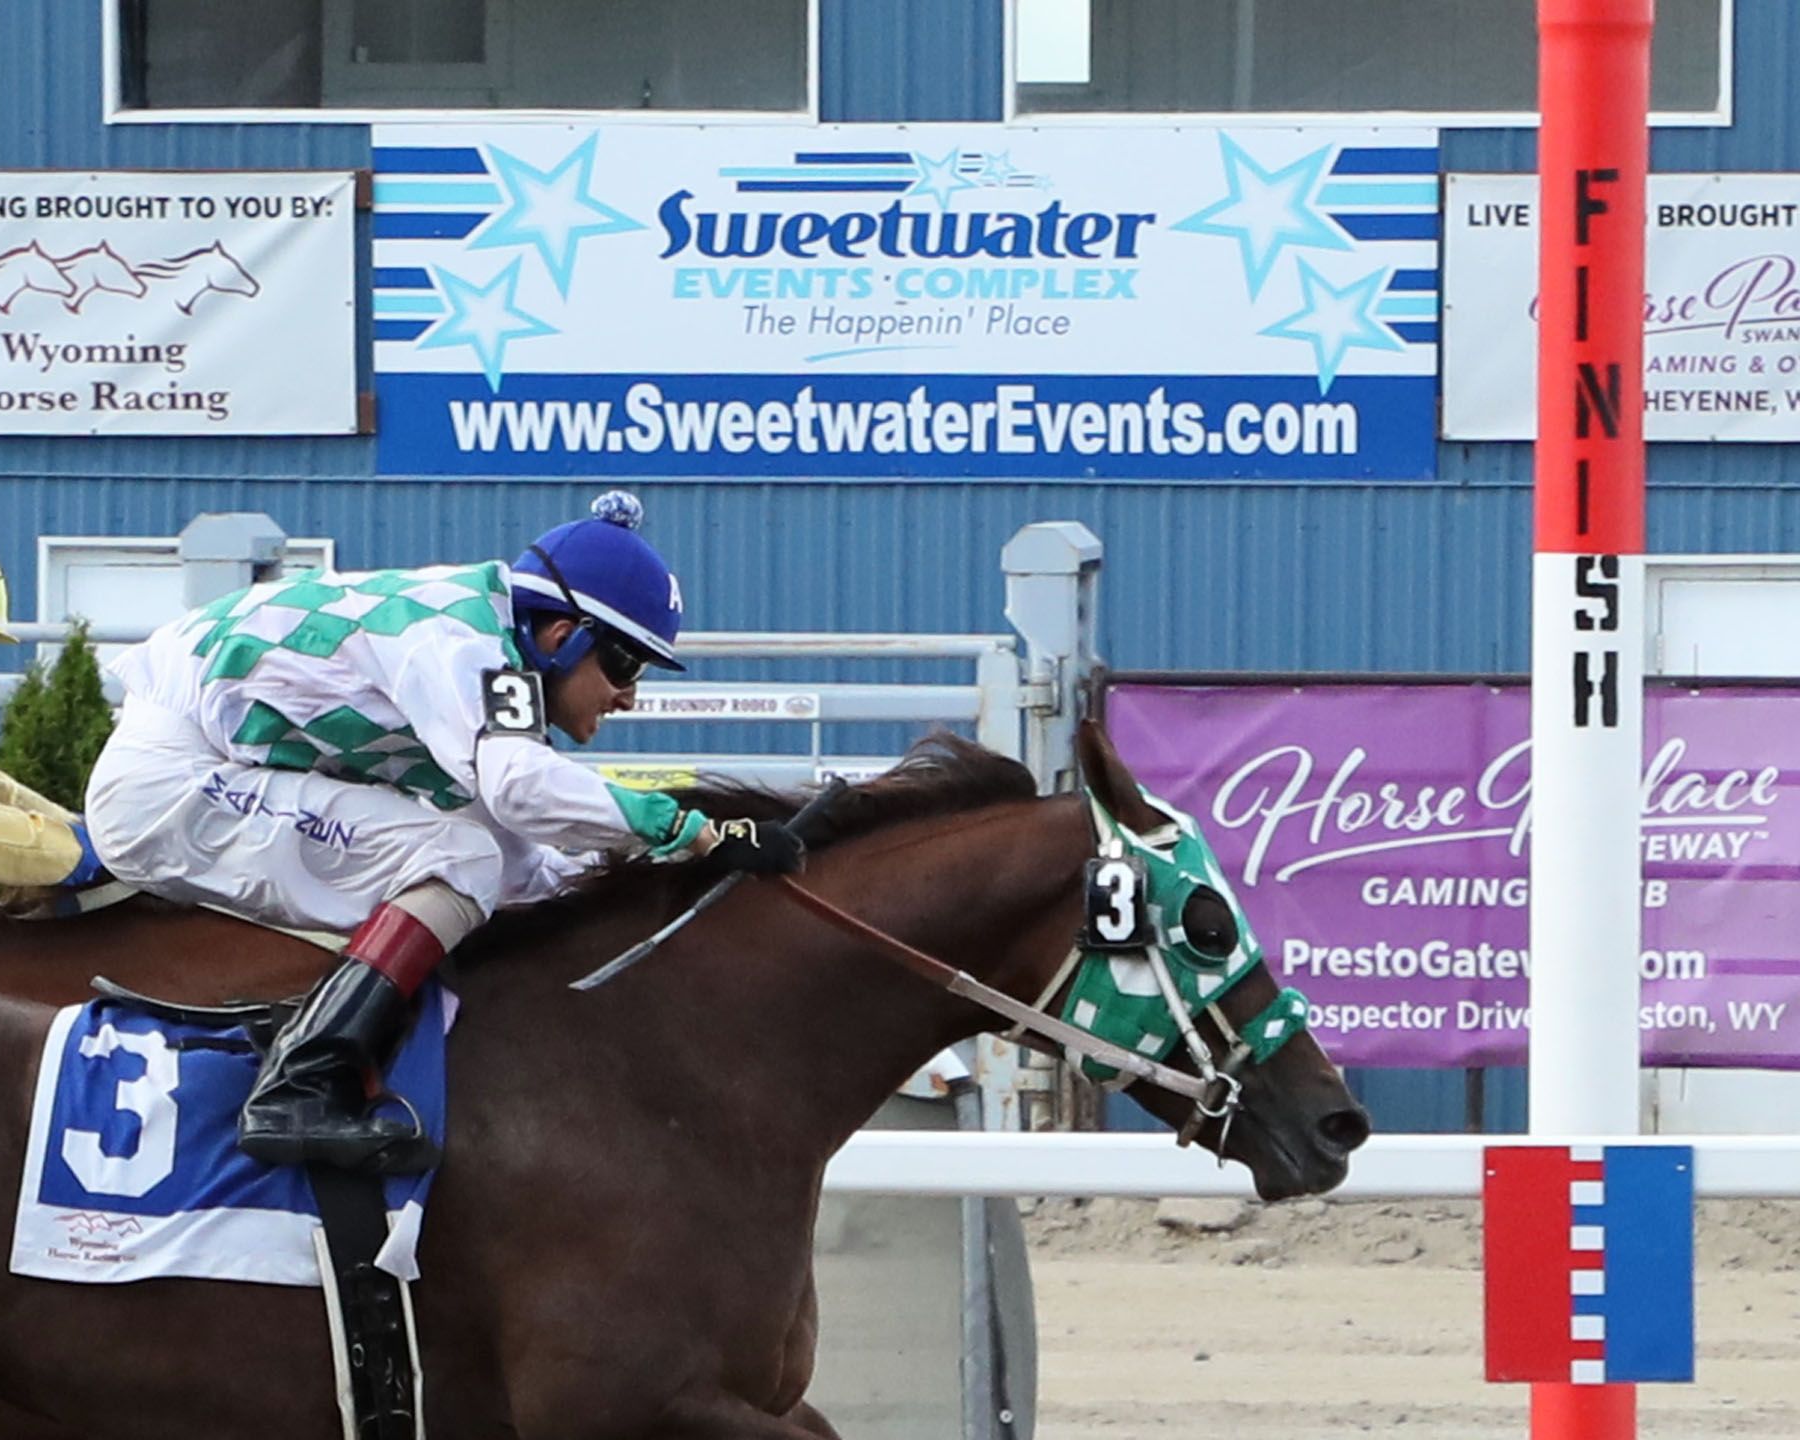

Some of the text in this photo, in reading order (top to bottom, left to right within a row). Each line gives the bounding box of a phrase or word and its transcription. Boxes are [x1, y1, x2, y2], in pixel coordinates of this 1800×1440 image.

[36, 196, 171, 219] BROUGHT
[179, 197, 217, 218] TO
[224, 197, 282, 218] YOU
[290, 197, 334, 218] BY:
[657, 188, 1157, 260] Sweetwater
[1468, 204, 1798, 228] LIVE BROUGHT
[672, 267, 1140, 300] EVENTS COMPLEX
[744, 302, 1071, 345] The Happenin' Place
[0, 332, 188, 373] Wyoming
[1646, 356, 1737, 374] AMING
[1750, 356, 1765, 374] &
[90, 380, 230, 421] Racing
[449, 382, 1358, 456] www.SweetwaterEvents.com
[1642, 389, 1777, 415] HEYENNE,
[1574, 168, 1620, 728] FINISH
[491, 674, 535, 730] 3
[1211, 745, 1468, 887] Horse
[1641, 830, 1750, 862] EWAY
[1095, 862, 1136, 942] 3
[1360, 876, 1529, 908] GAMING
[1306, 1001, 1449, 1034] ospector
[1727, 1001, 1787, 1032] WY
[61, 1022, 180, 1199] 3
